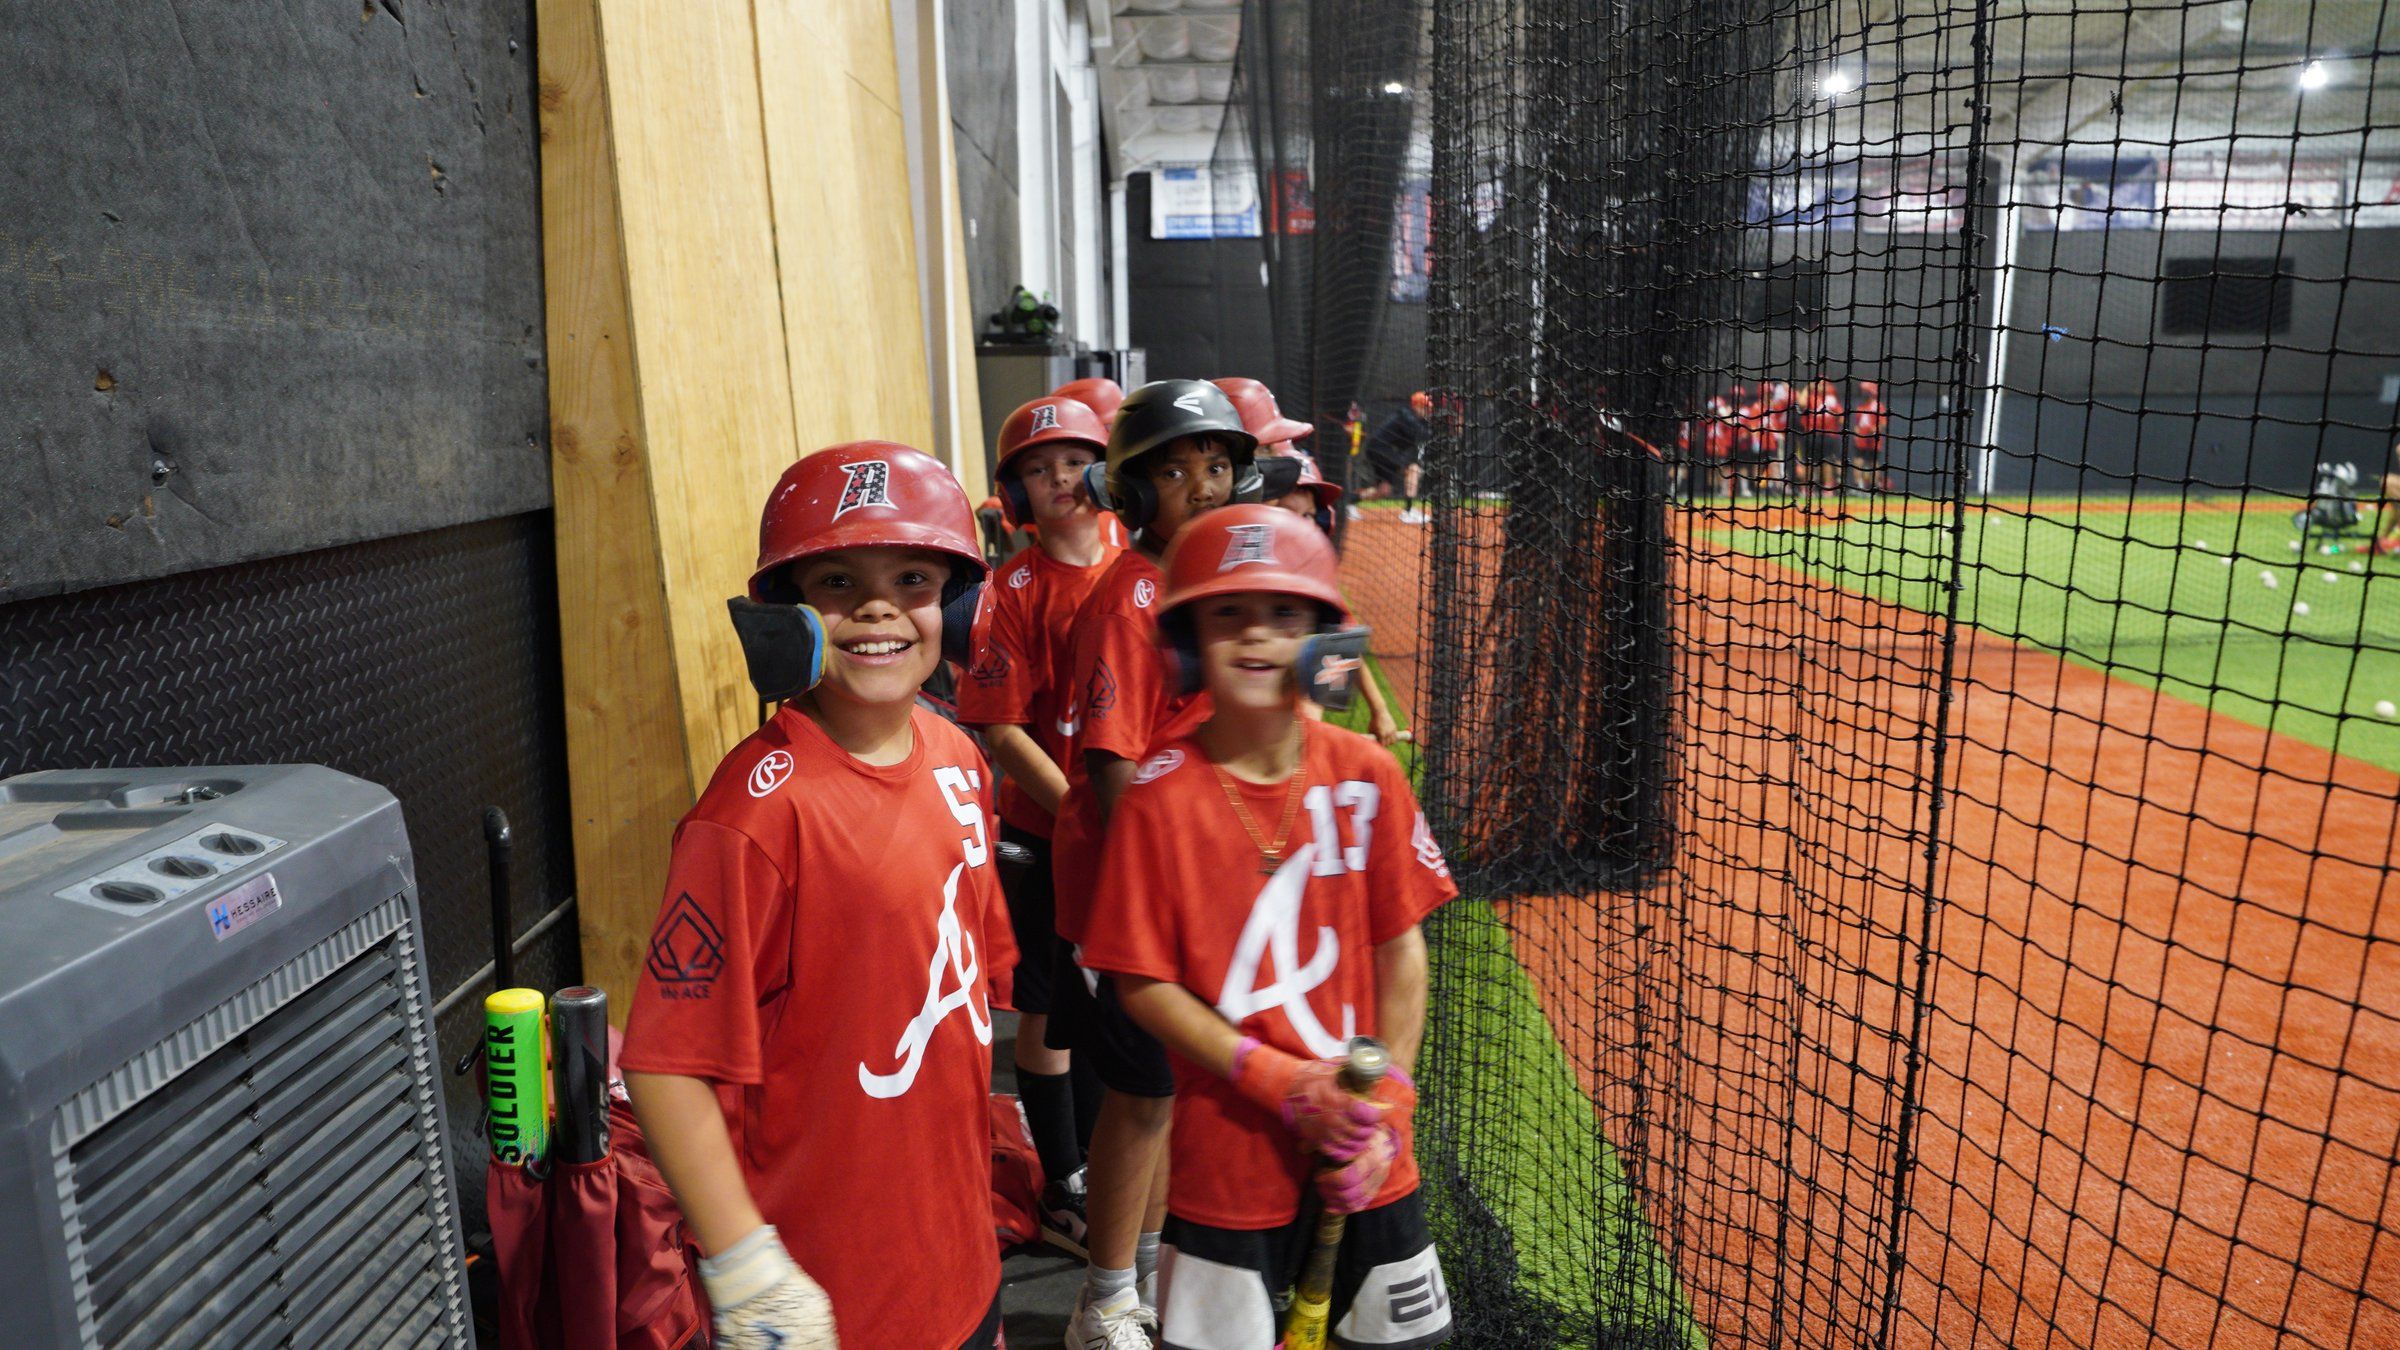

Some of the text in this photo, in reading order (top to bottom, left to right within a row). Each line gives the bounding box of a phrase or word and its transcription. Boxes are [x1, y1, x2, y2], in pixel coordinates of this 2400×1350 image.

[1031, 404, 1062, 437] A
[832, 461, 899, 523] A
[1303, 781, 1381, 876] 13
[231, 887, 277, 918] HESSAIRE
[858, 862, 992, 1099] A
[487, 1025, 521, 1166] SOLDIER
